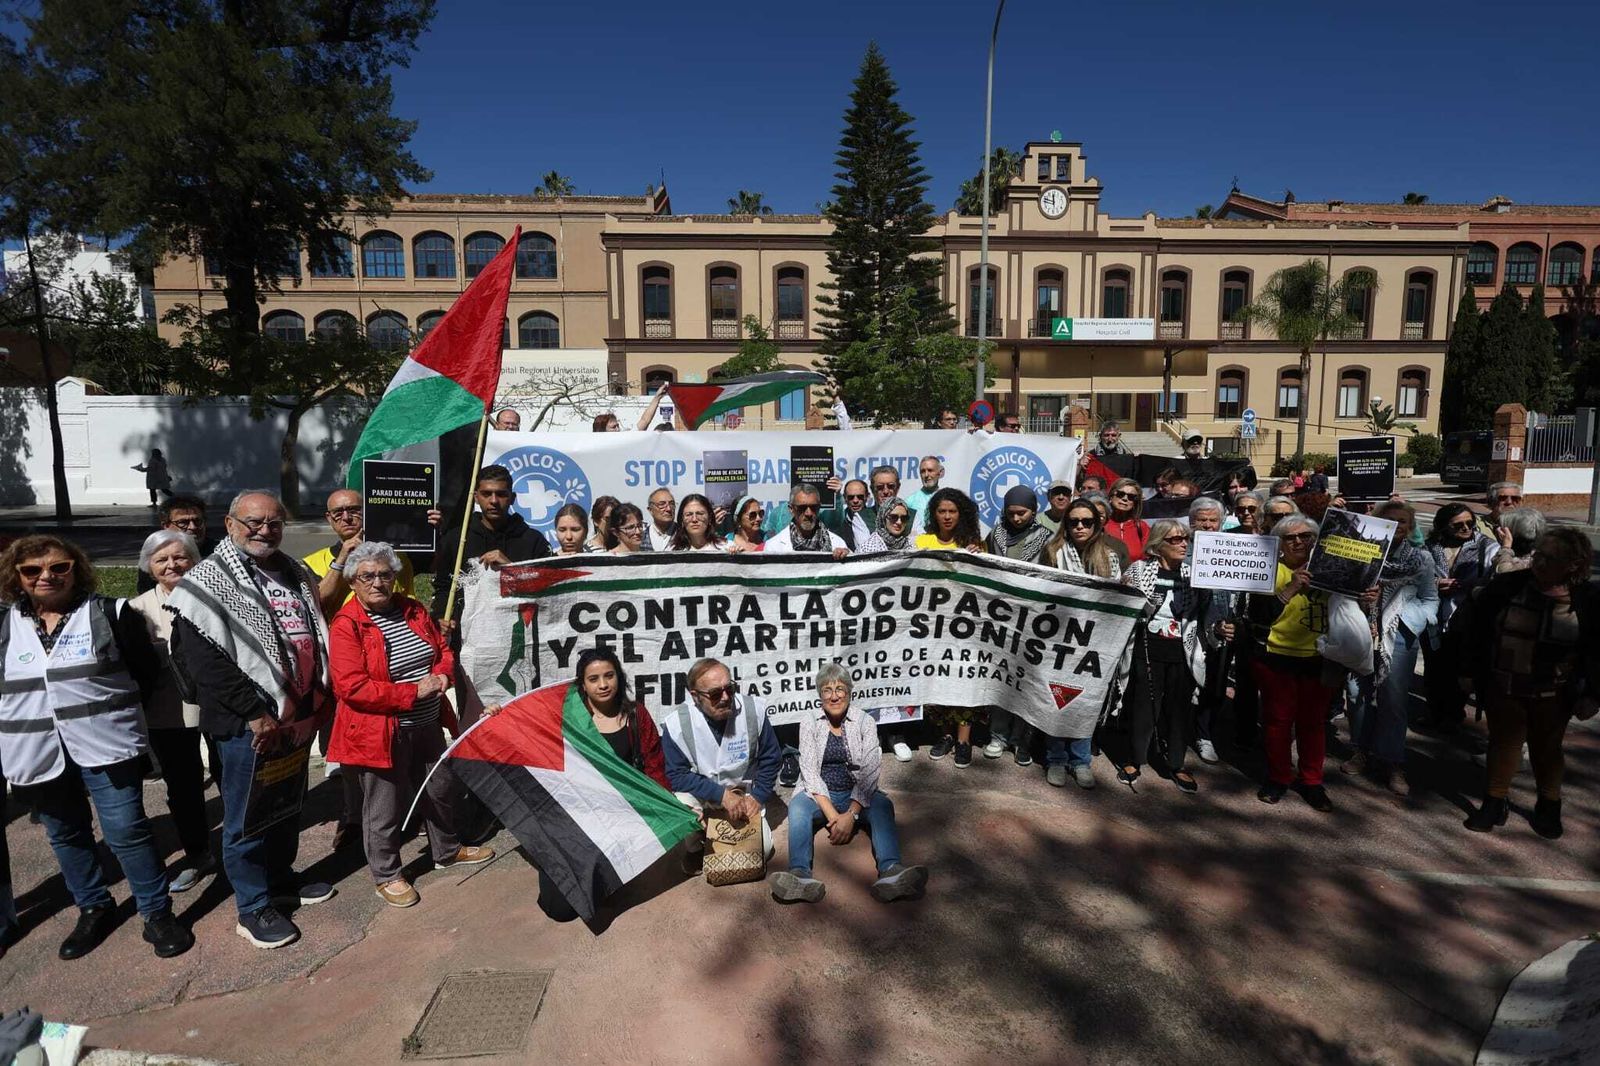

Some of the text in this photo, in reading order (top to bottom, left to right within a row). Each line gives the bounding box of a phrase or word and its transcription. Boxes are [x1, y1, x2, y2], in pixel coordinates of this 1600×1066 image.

[520, 366, 551, 376] Regional
[553, 366, 600, 375] Universitario
[624, 460, 686, 487] STOP
[977, 451, 1036, 481] MÉDICOS
[372, 489, 427, 498] PARAD DE ATACAR
[974, 490, 992, 519] DEL
[1211, 548, 1232, 556] HACE
[1233, 549, 1270, 558] CÓMPLICE
[1225, 540, 1258, 549] SILENCIO
[1210, 557, 1267, 569] GENOCIDIO
[1211, 570, 1269, 582] APARTHEID
[568, 585, 1096, 647] CONTRA LA OCUPACIÓN
[547, 612, 1102, 679] Y EL APARTHEID SIONISTA
[734, 666, 743, 681] L
[902, 648, 928, 662] DE
[941, 648, 1026, 679] ARMAS
[780, 665, 902, 693] RELONES
[908, 664, 951, 678] CON
[958, 665, 1023, 692] ISRAEL
